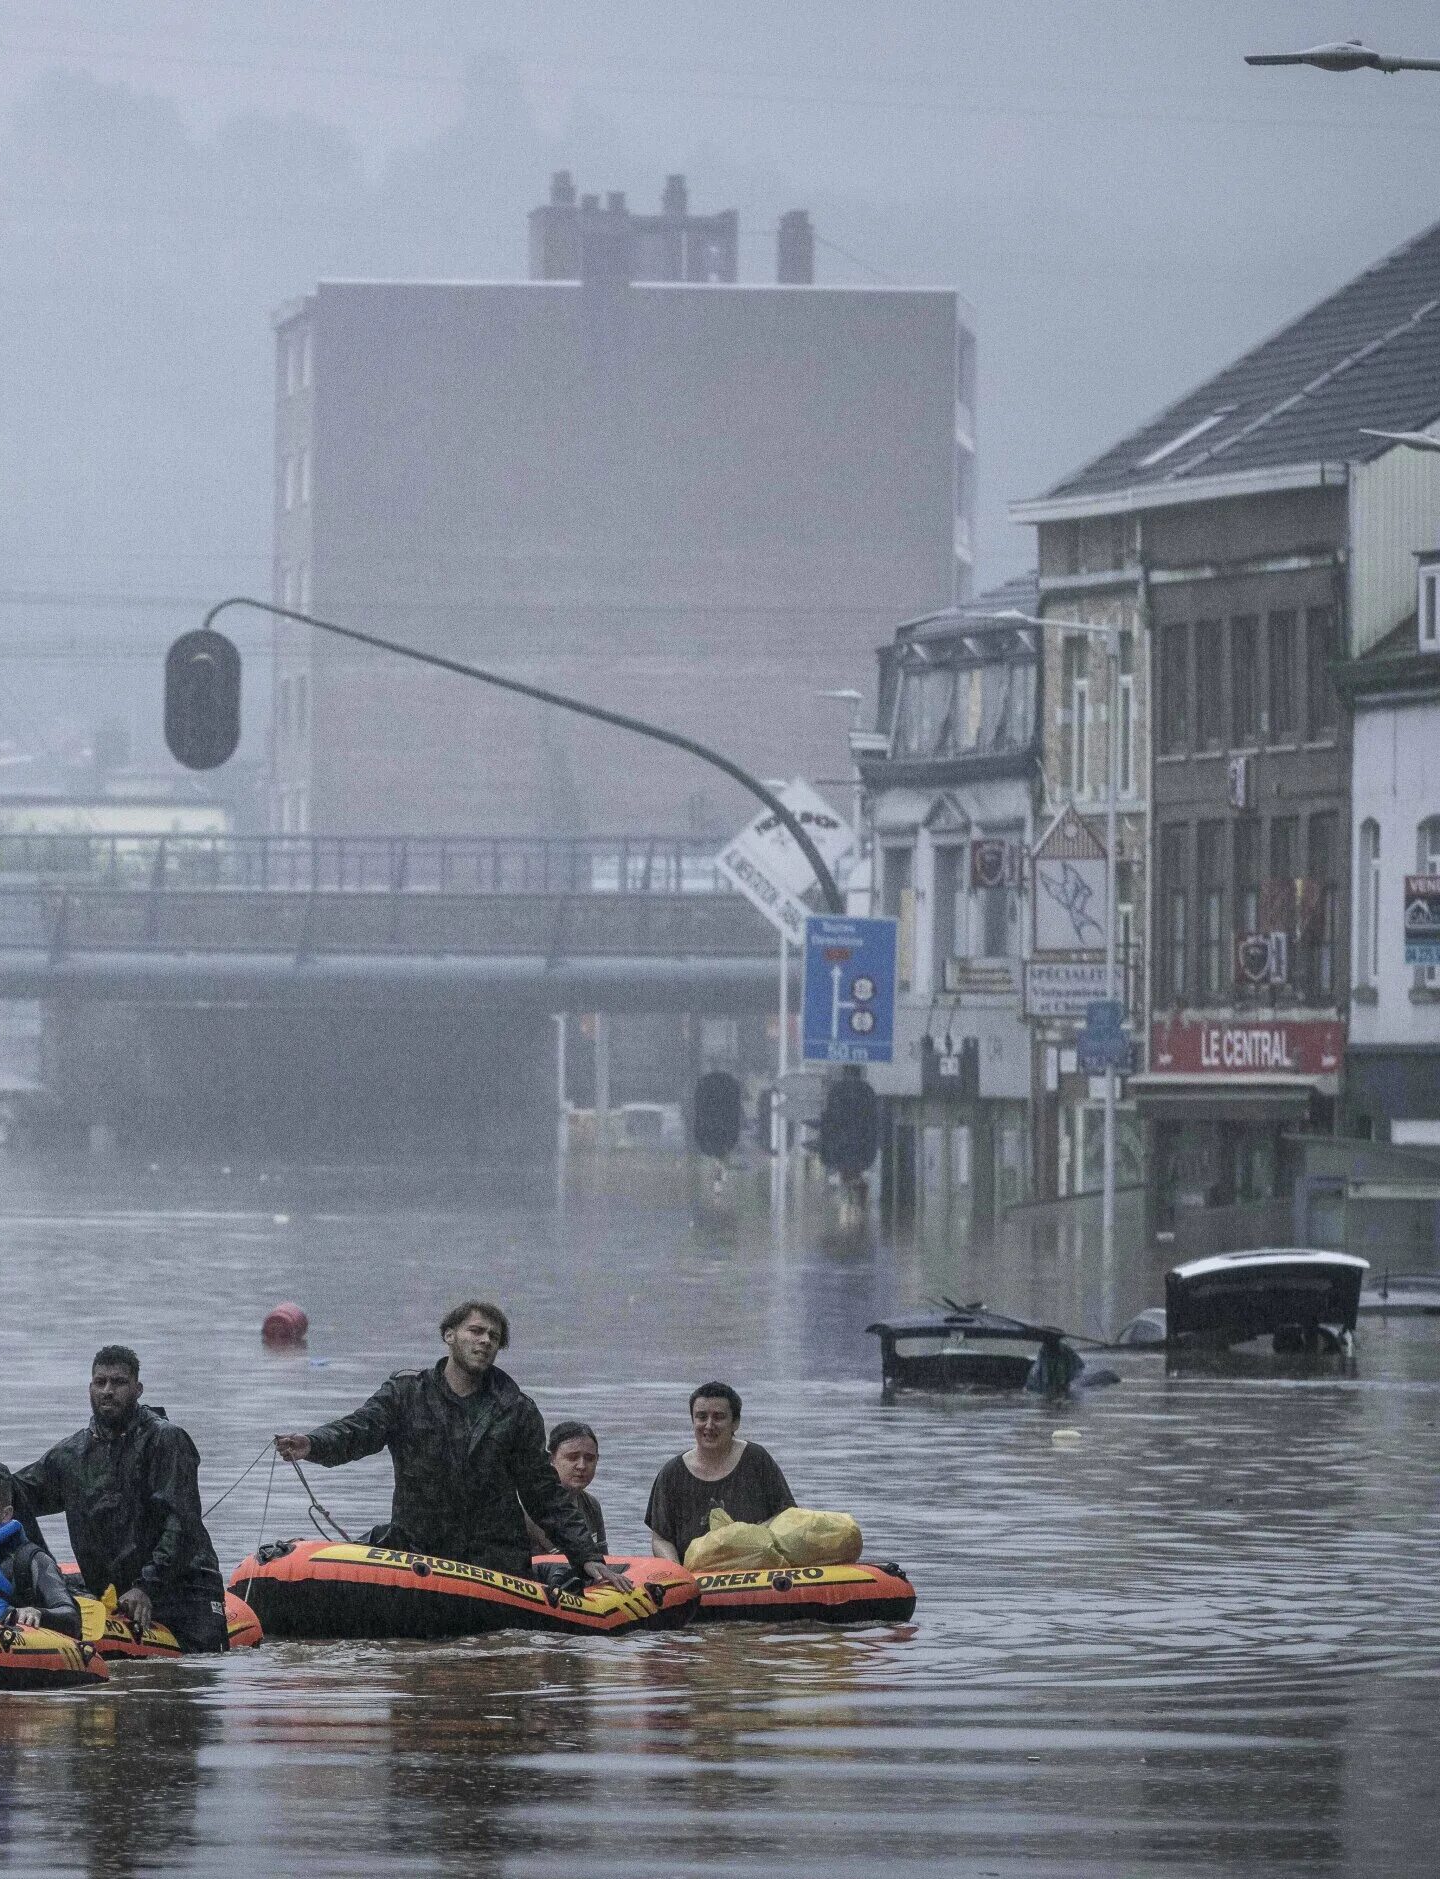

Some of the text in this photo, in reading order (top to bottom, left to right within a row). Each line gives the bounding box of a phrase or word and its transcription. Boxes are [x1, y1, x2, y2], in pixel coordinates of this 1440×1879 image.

[1201, 1030, 1292, 1066] LE CENTRAL
[367, 1548, 537, 1596] EXPLORER PRO
[696, 1567, 824, 1589] ORER PRO
[560, 1593, 582, 1607] 200
[105, 1619, 124, 1634] RO
